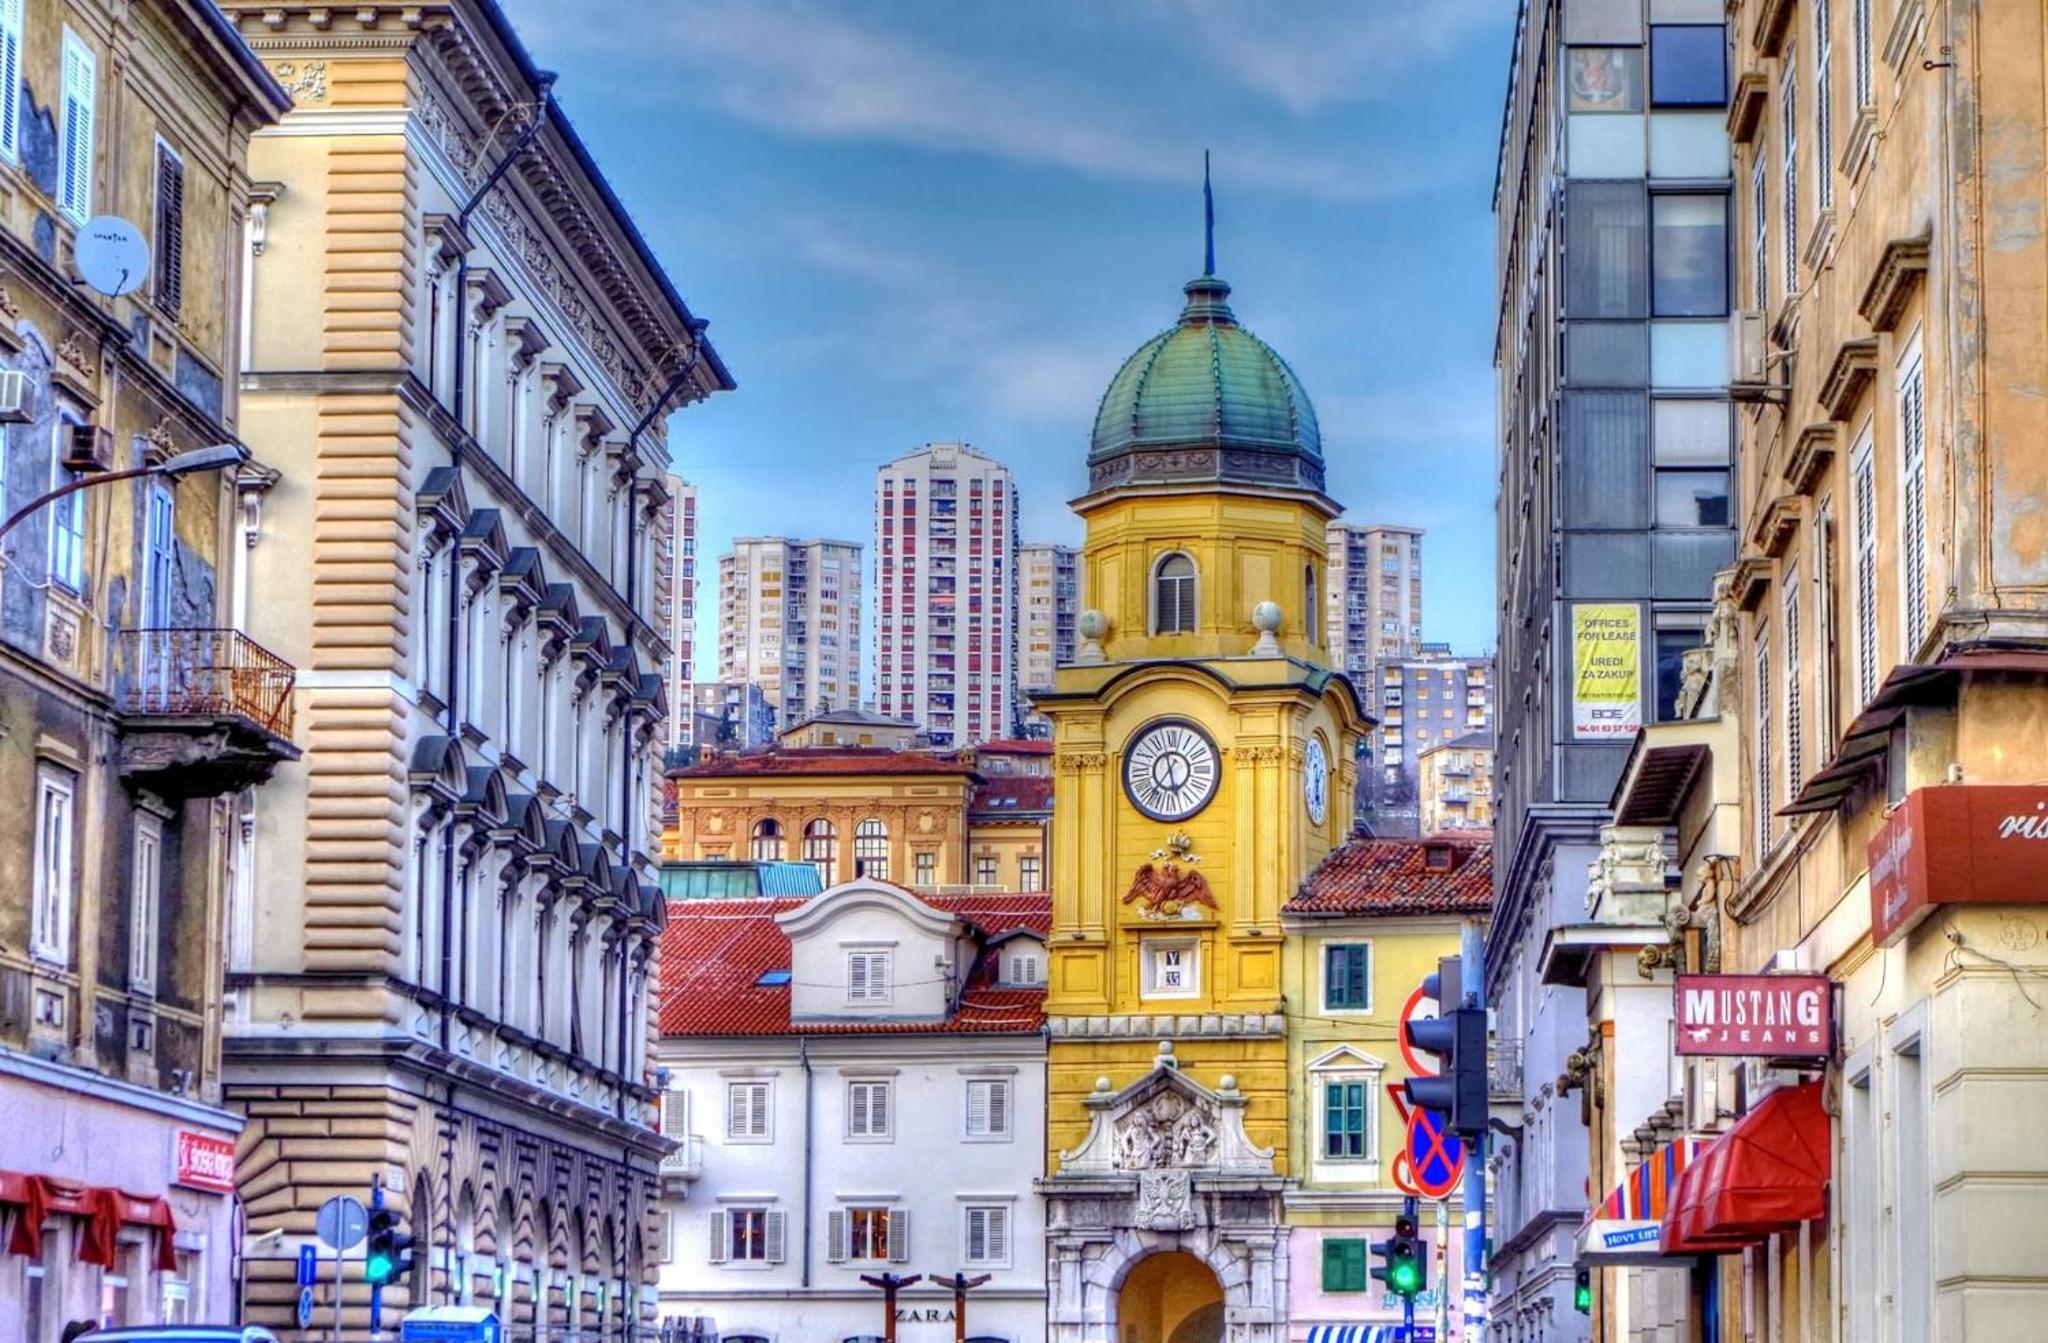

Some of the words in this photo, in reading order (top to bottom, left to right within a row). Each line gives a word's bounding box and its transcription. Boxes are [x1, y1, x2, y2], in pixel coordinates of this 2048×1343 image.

[1584, 619, 1629, 629] OFFICES
[1577, 632, 1600, 641] FOR
[1602, 631, 1637, 641] LEASE
[1591, 657, 1623, 667] UREDI
[1582, 670, 1595, 679] ZA
[1597, 670, 1634, 679] ZAKUP
[1685, 989, 1819, 1026] MUSTANG
[1720, 1030, 1819, 1043] JEANS
[1638, 1229, 1658, 1240] LIST
[896, 1309, 956, 1321] ZARA
